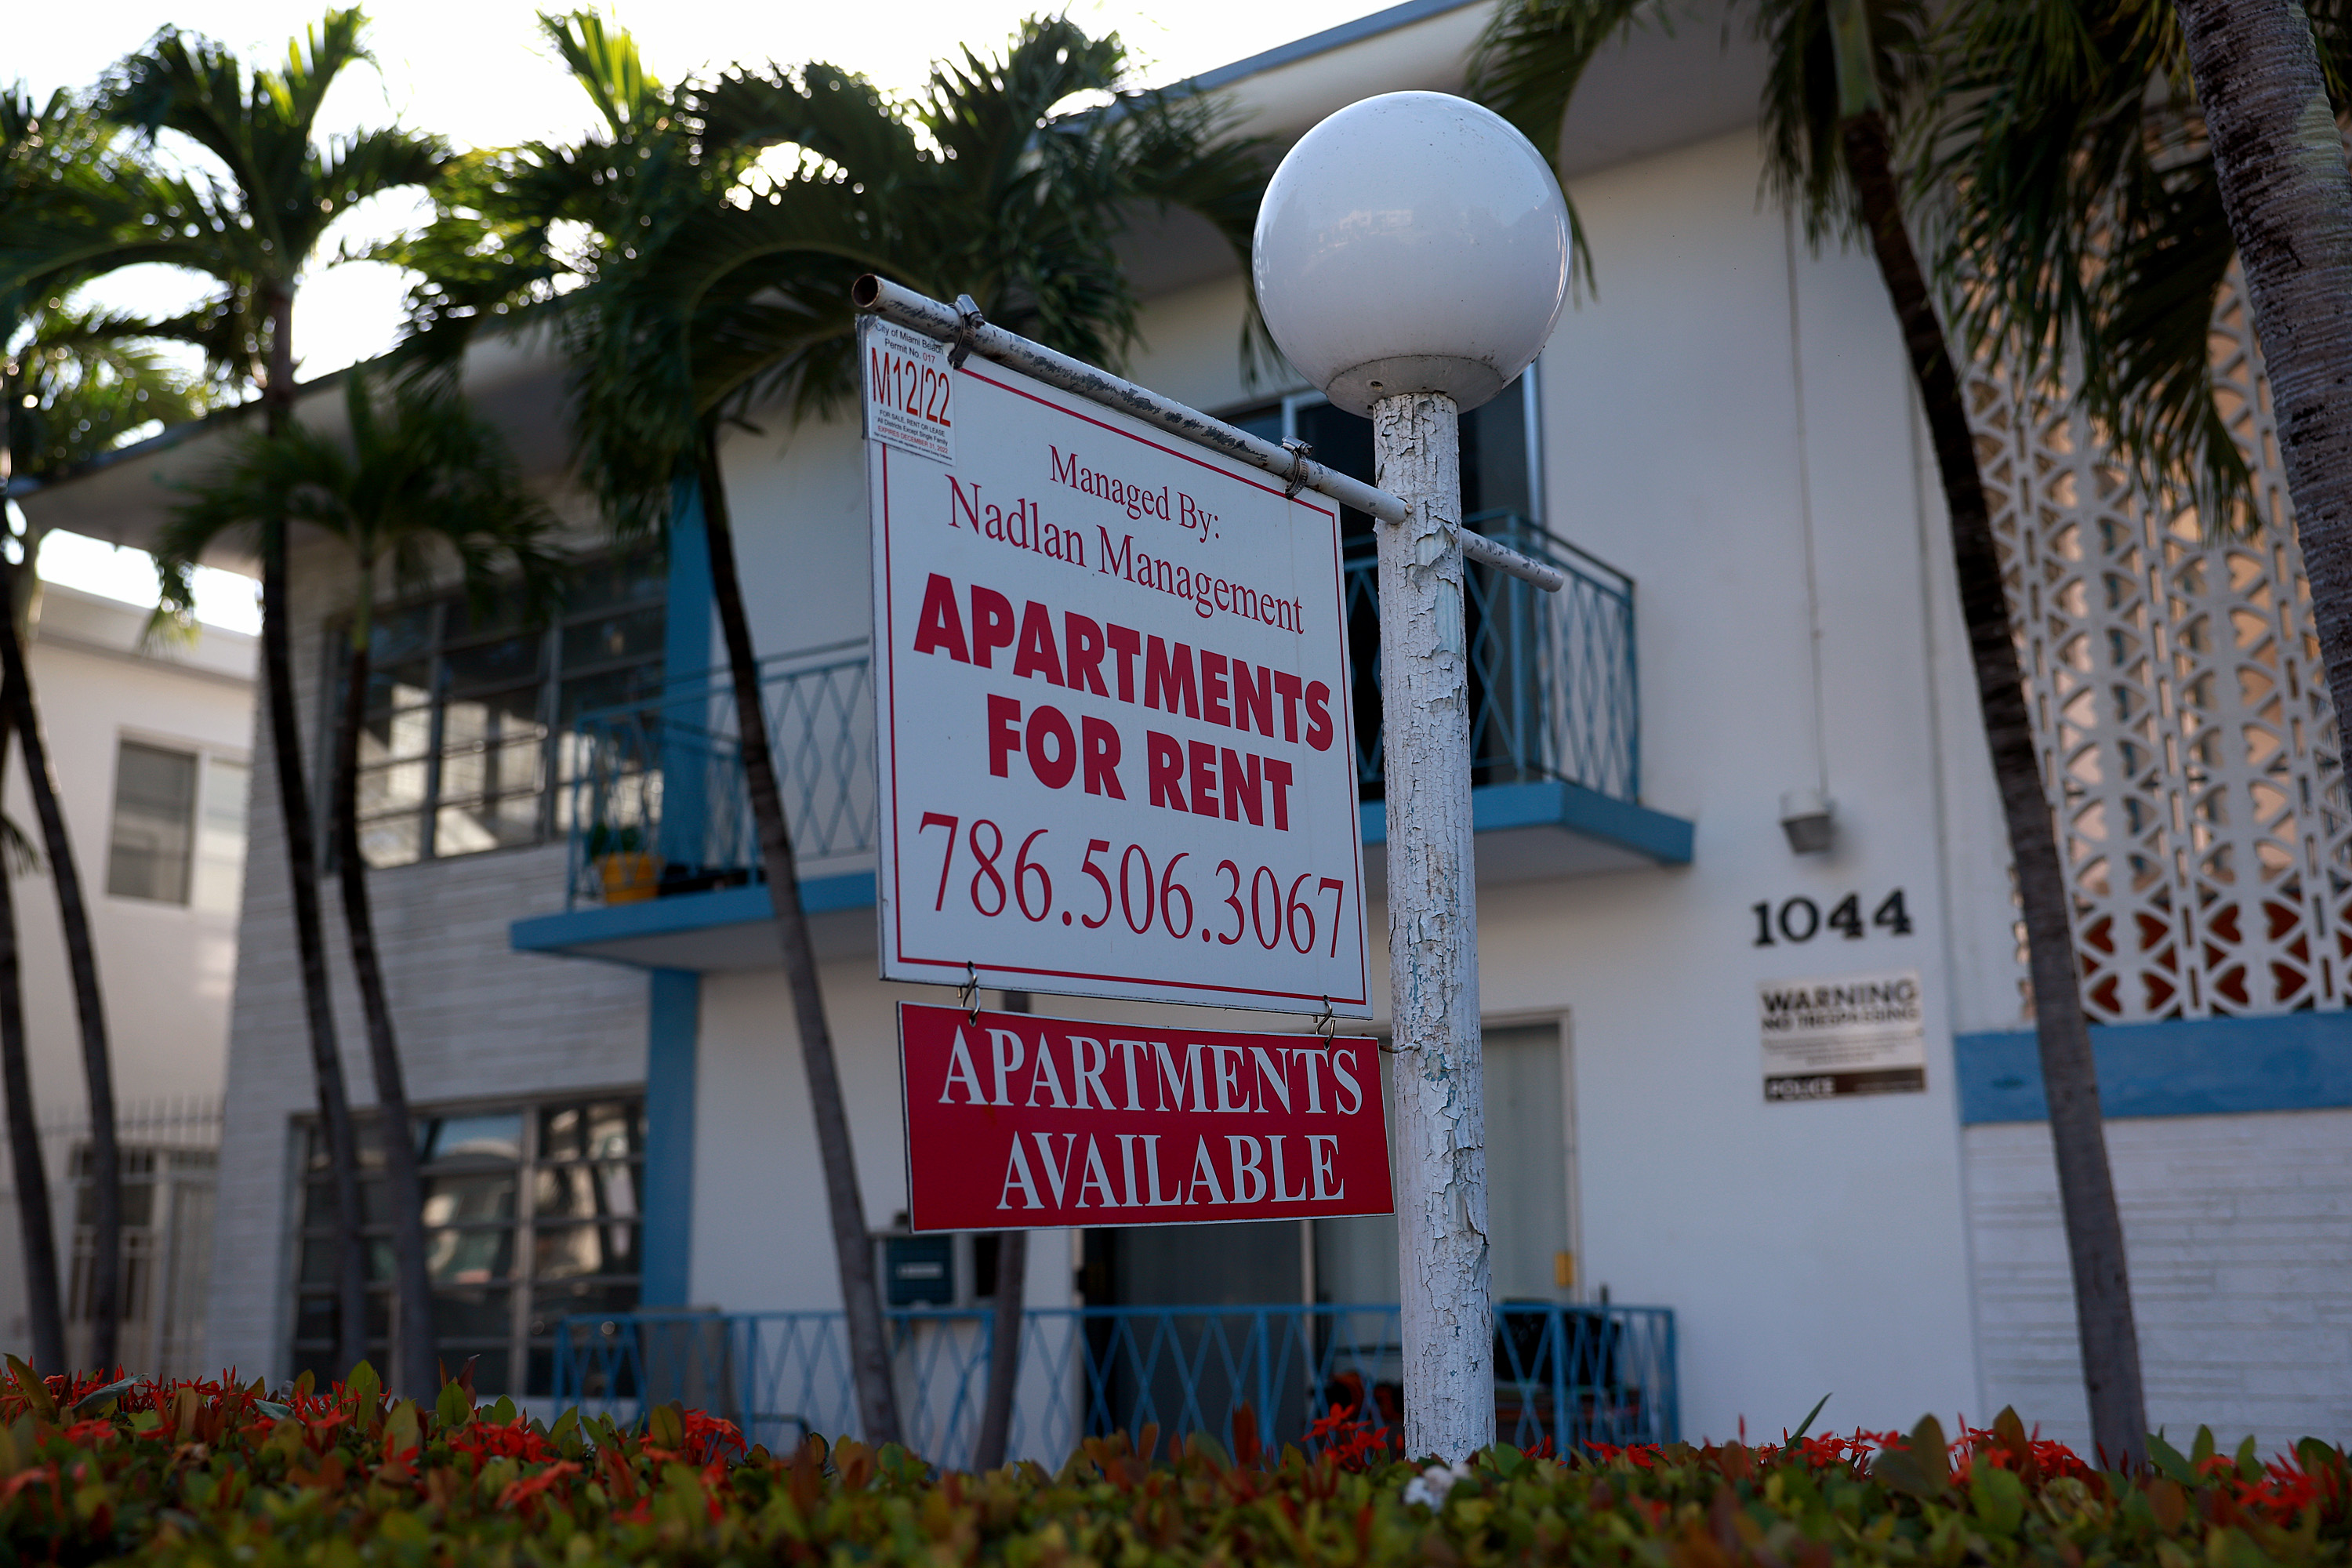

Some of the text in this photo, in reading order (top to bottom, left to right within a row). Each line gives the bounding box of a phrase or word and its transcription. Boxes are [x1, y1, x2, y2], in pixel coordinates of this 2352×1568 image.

[876, 323, 889, 336] City
[900, 331, 920, 346] Miami
[922, 339, 943, 354] Beach
[884, 338, 935, 364] Permit No. 017
[872, 347, 951, 427] M12/22
[878, 425, 899, 437] EXPIRES
[901, 433, 928, 447] DECEMBER
[937, 445, 948, 454] 2022
[884, 419, 902, 430] Districts
[903, 426, 918, 436] Except
[934, 436, 948, 446] Family
[907, 419, 920, 428] RENT
[930, 426, 945, 437] LEASE
[1049, 445, 1220, 544] Managed By:
[945, 474, 1305, 635] Nadlan Management
[913, 572, 1334, 752] APARTMENTS
[987, 693, 1293, 832] FOR RENT
[918, 811, 1345, 958] 786.506.3067
[1753, 887, 1911, 946] 1044
[1762, 980, 1915, 1011] WARNING
[938, 1024, 1363, 1115] APARTMENTS
[996, 1131, 1345, 1210] AVAILABLE
